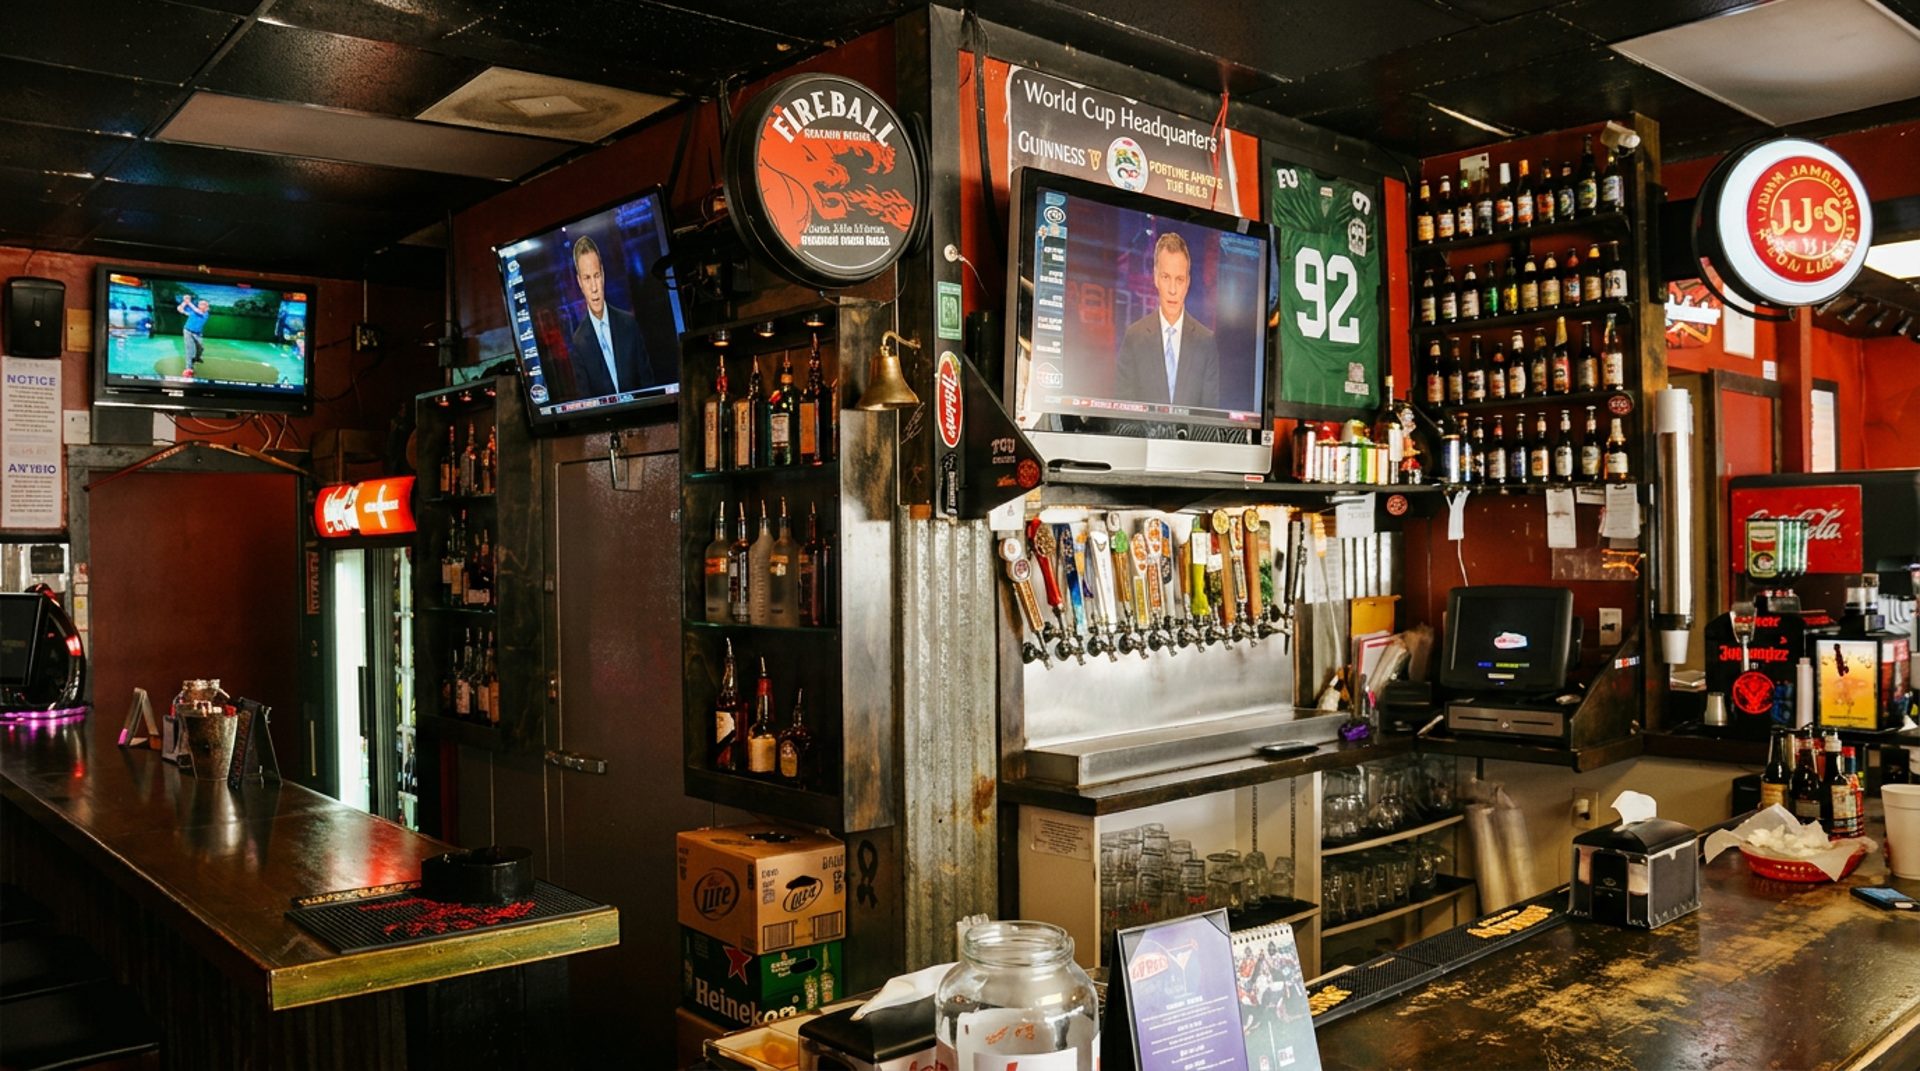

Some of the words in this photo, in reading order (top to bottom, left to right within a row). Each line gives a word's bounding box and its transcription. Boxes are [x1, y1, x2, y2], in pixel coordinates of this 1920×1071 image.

[772, 90, 895, 148] FIREBALL
[1024, 80, 1076, 115] World
[1082, 97, 1116, 130] Cup
[1121, 107, 1217, 153] Headquarters
[1018, 130, 1086, 167] GUINNESS
[1295, 246, 1360, 344] 92
[6, 374, 57, 386] NOTICE
